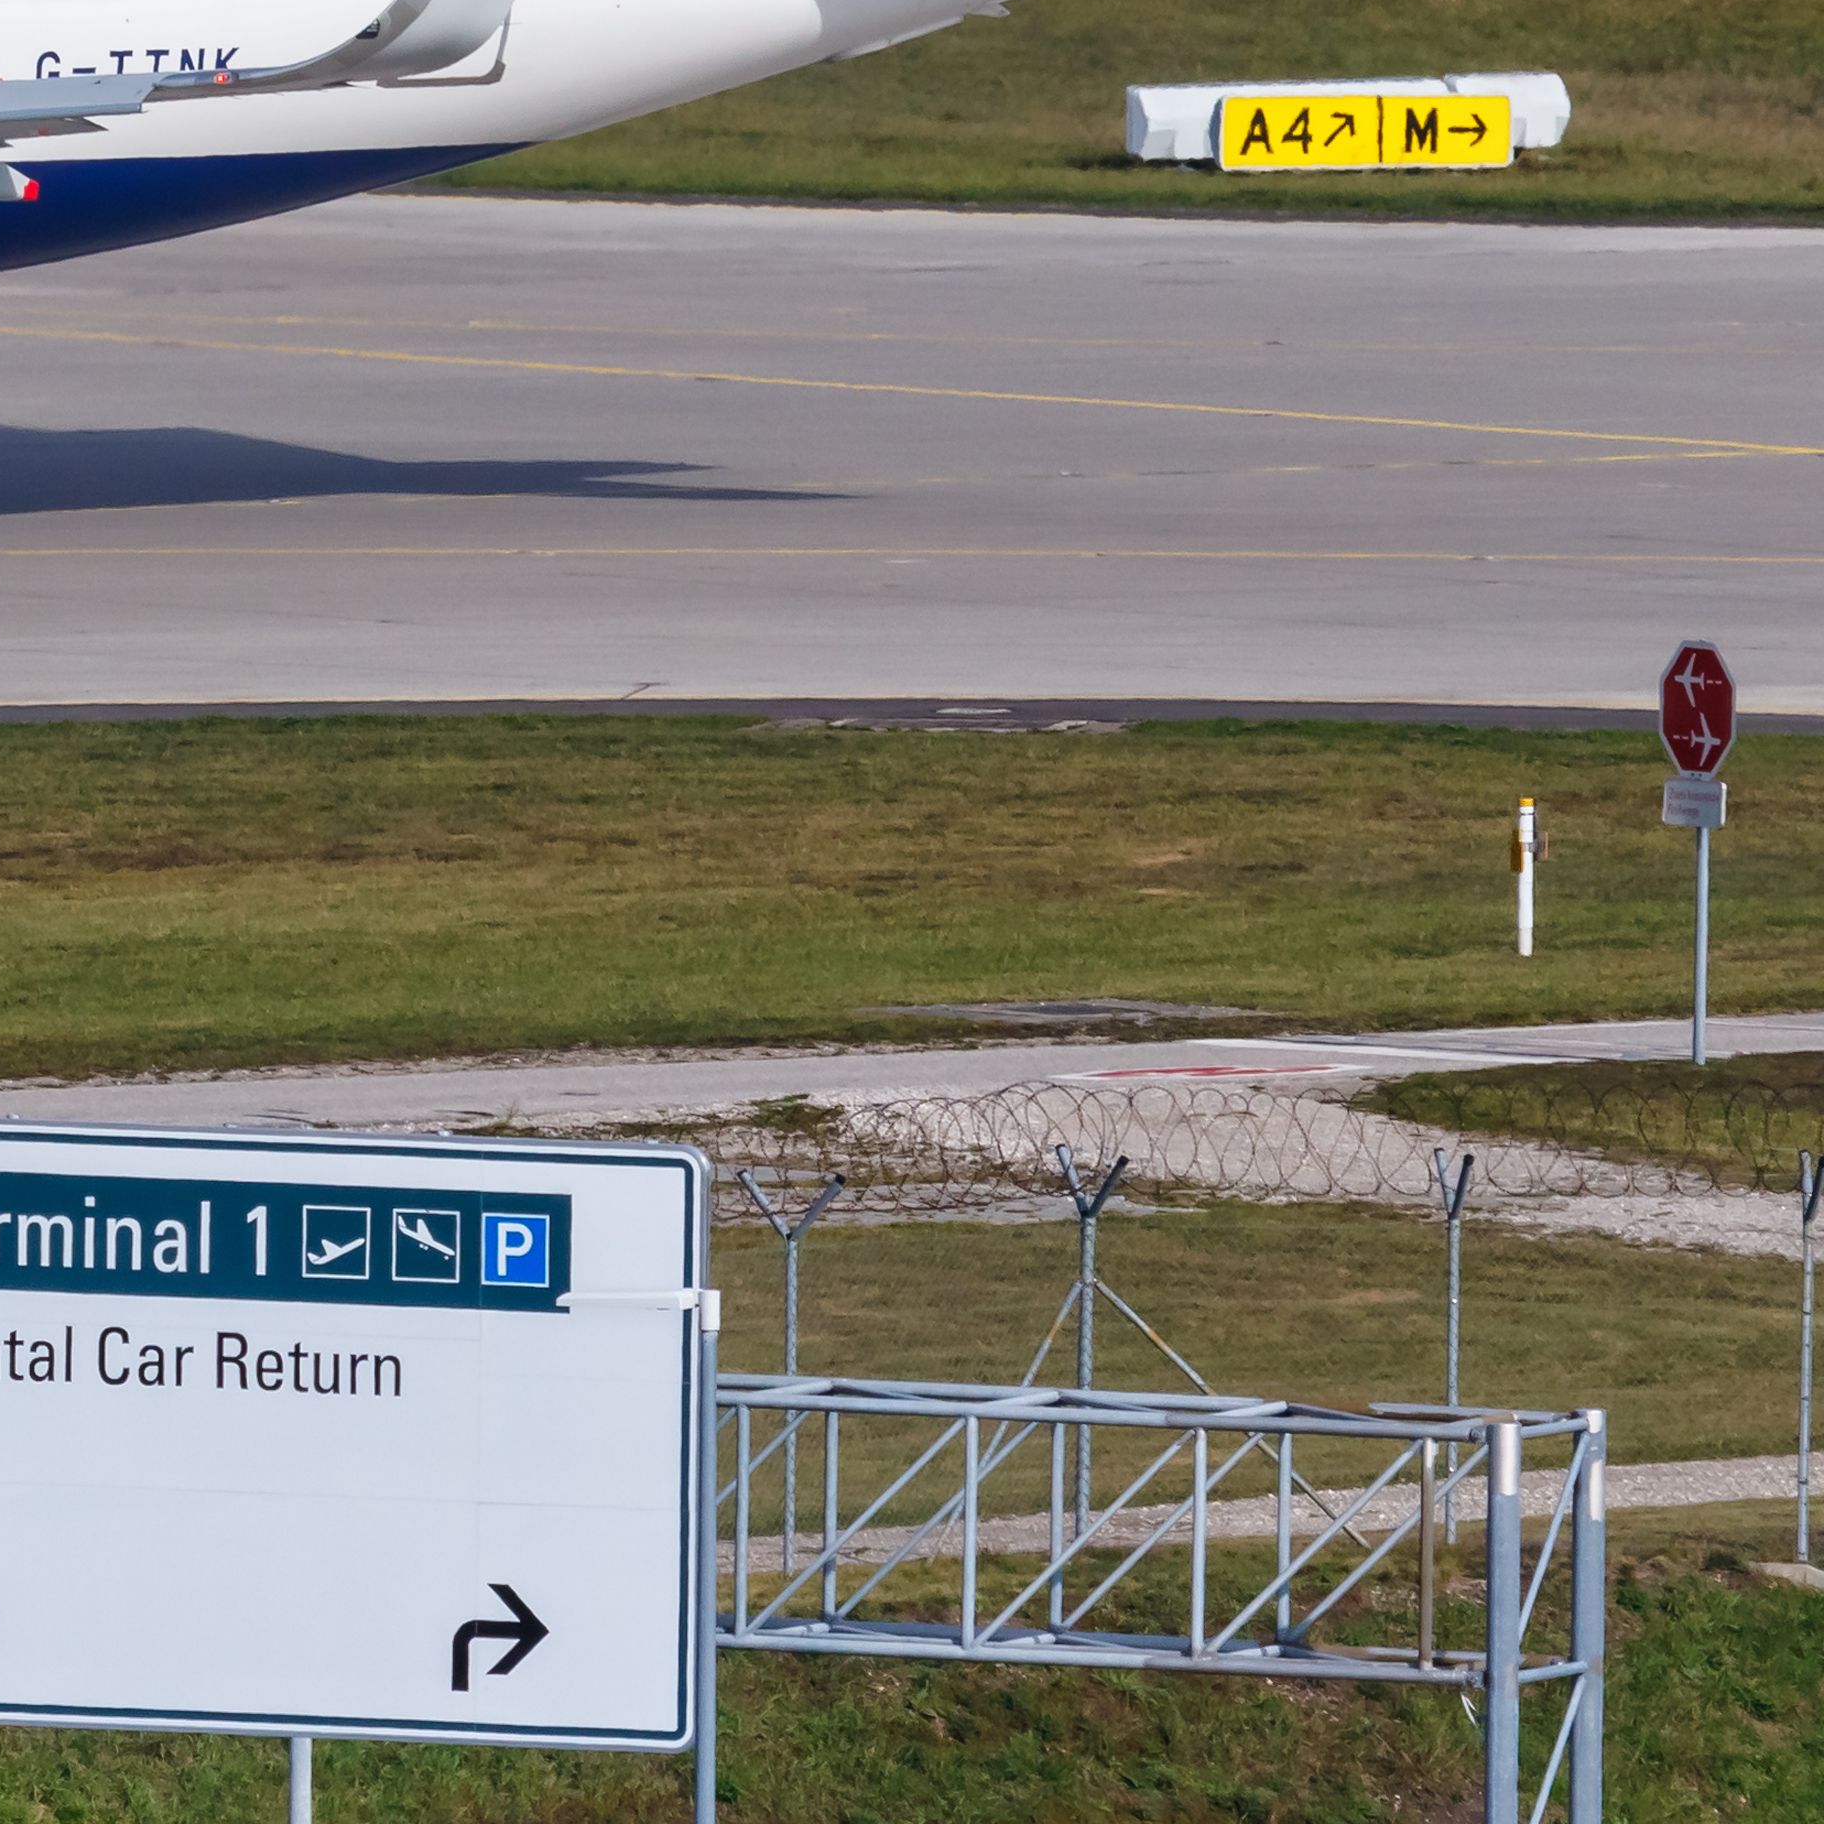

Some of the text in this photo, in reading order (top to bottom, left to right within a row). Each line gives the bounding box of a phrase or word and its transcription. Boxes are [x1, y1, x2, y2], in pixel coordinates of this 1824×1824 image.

[1240, 107, 1438, 155] A4 M
[246, 1205, 267, 1276] 1
[98, 1326, 194, 1386] Car
[216, 1332, 402, 1396] Return
